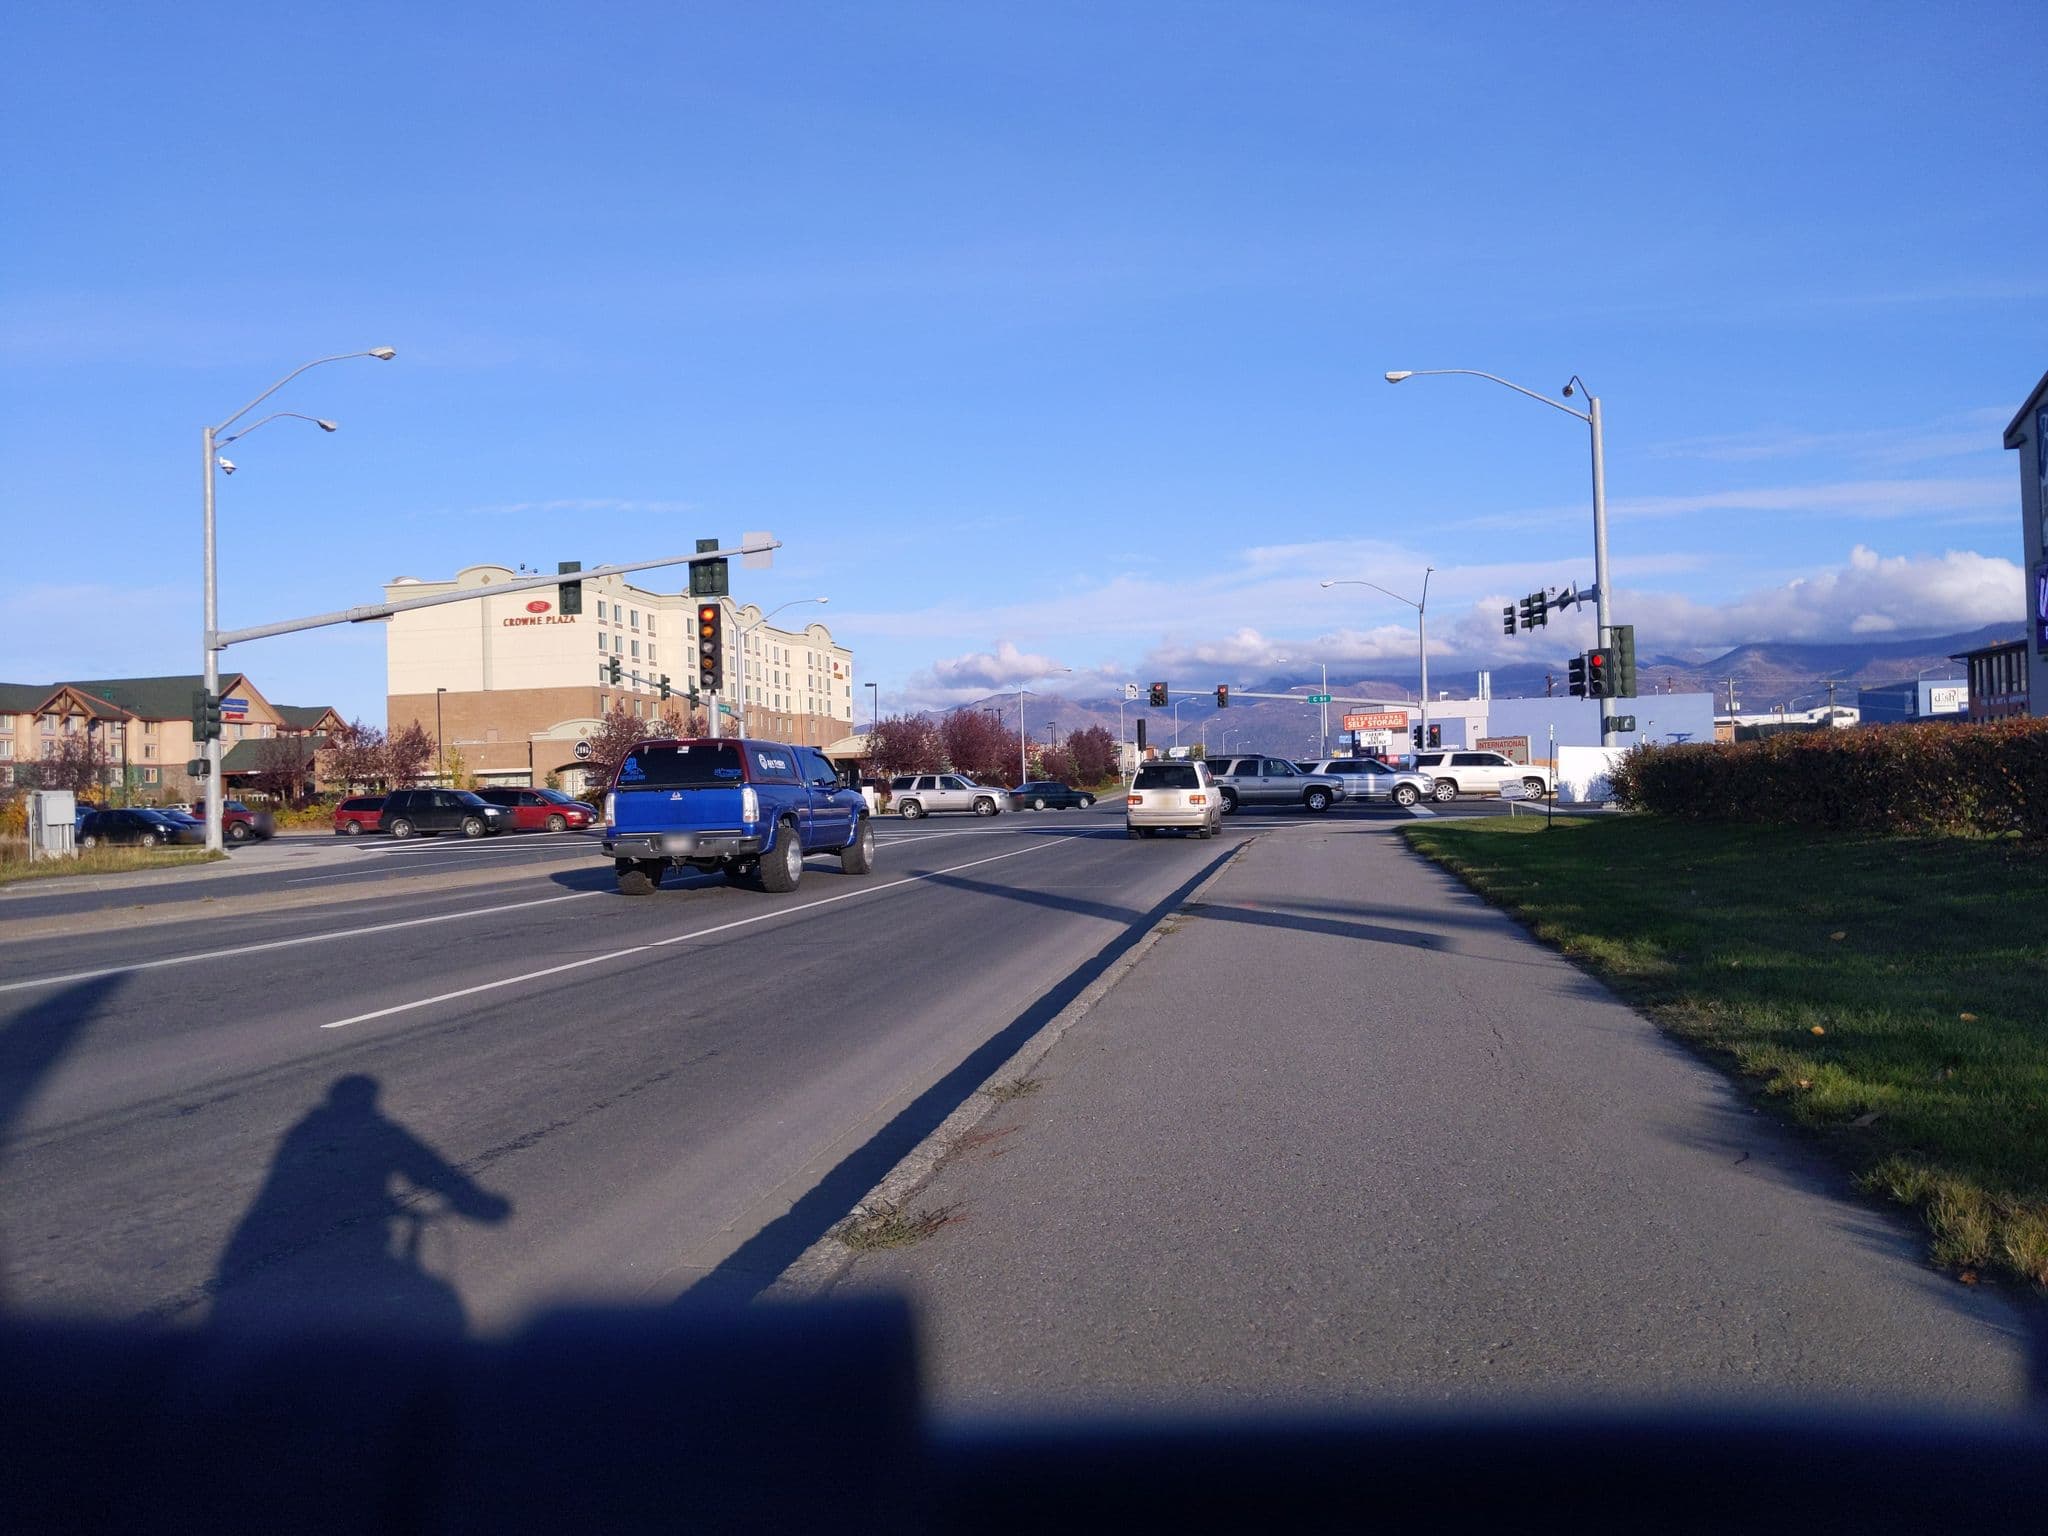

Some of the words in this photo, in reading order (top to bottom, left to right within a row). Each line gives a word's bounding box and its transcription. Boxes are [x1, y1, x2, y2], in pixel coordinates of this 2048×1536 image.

[503, 616, 542, 626] CROWNE
[545, 615, 576, 624] PLAZA
[1347, 720, 1365, 728] SELF
[1367, 718, 1404, 727] STORAGE
[1477, 740, 1526, 749] INTERNATIONAL
